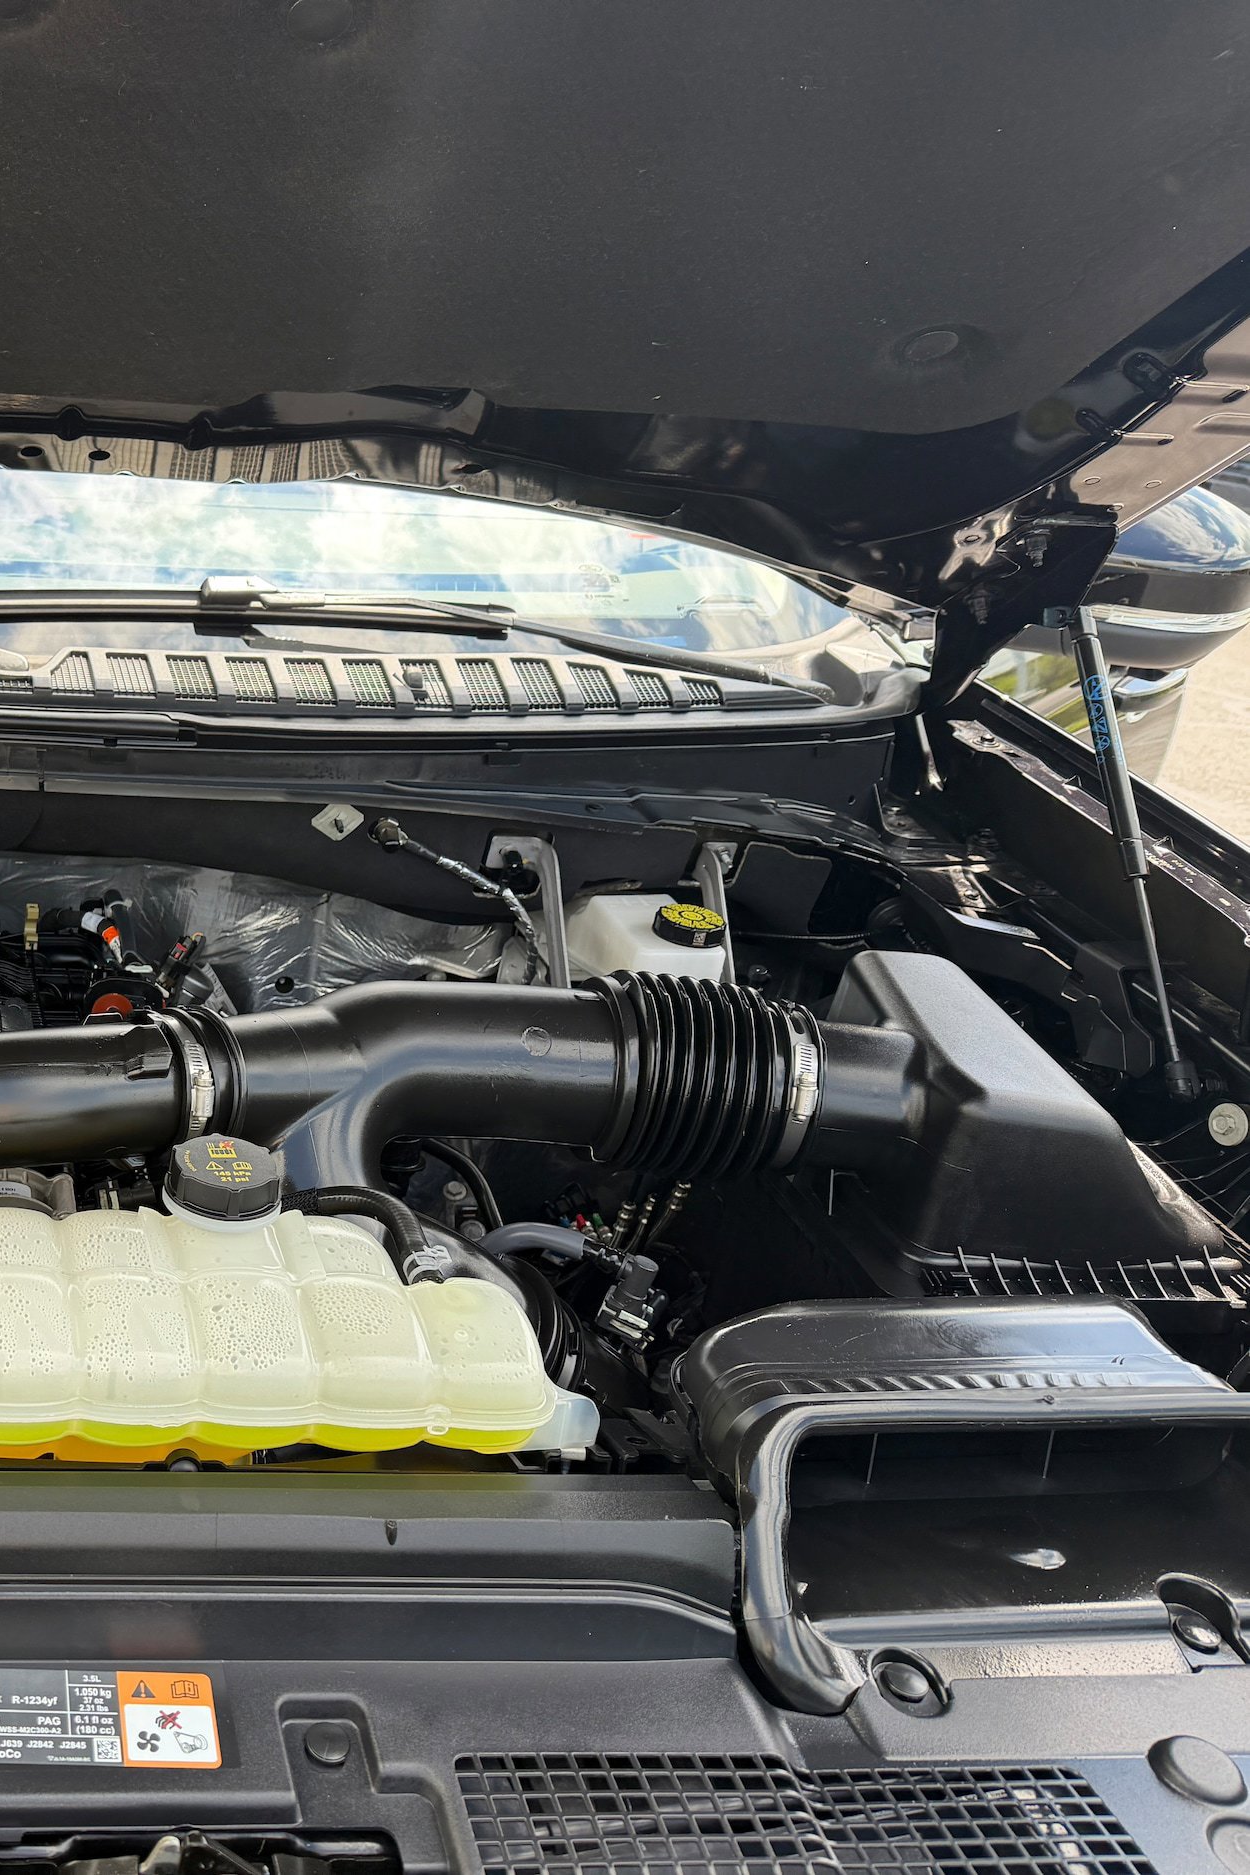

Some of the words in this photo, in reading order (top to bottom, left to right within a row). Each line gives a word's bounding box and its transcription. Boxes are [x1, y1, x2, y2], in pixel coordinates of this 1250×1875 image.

[82, 1674, 102, 1683] 3.5L
[74, 1687, 99, 1697] 1.050
[100, 1688, 112, 1699] kg
[11, 1695, 58, 1707] R-1234yf
[79, 1704, 96, 1712] 2.31
[37, 1716, 61, 1726] PAG
[75, 1715, 89, 1724] 6.1
[91, 1715, 100, 1724] fl
[100, 1717, 114, 1725] oz
[76, 1725, 98, 1735] (180
[99, 1726, 116, 1736] cc)
[0, 1739, 24, 1748] J639
[26, 1740, 55, 1749] J2842
[59, 1741, 87, 1750] J2845
